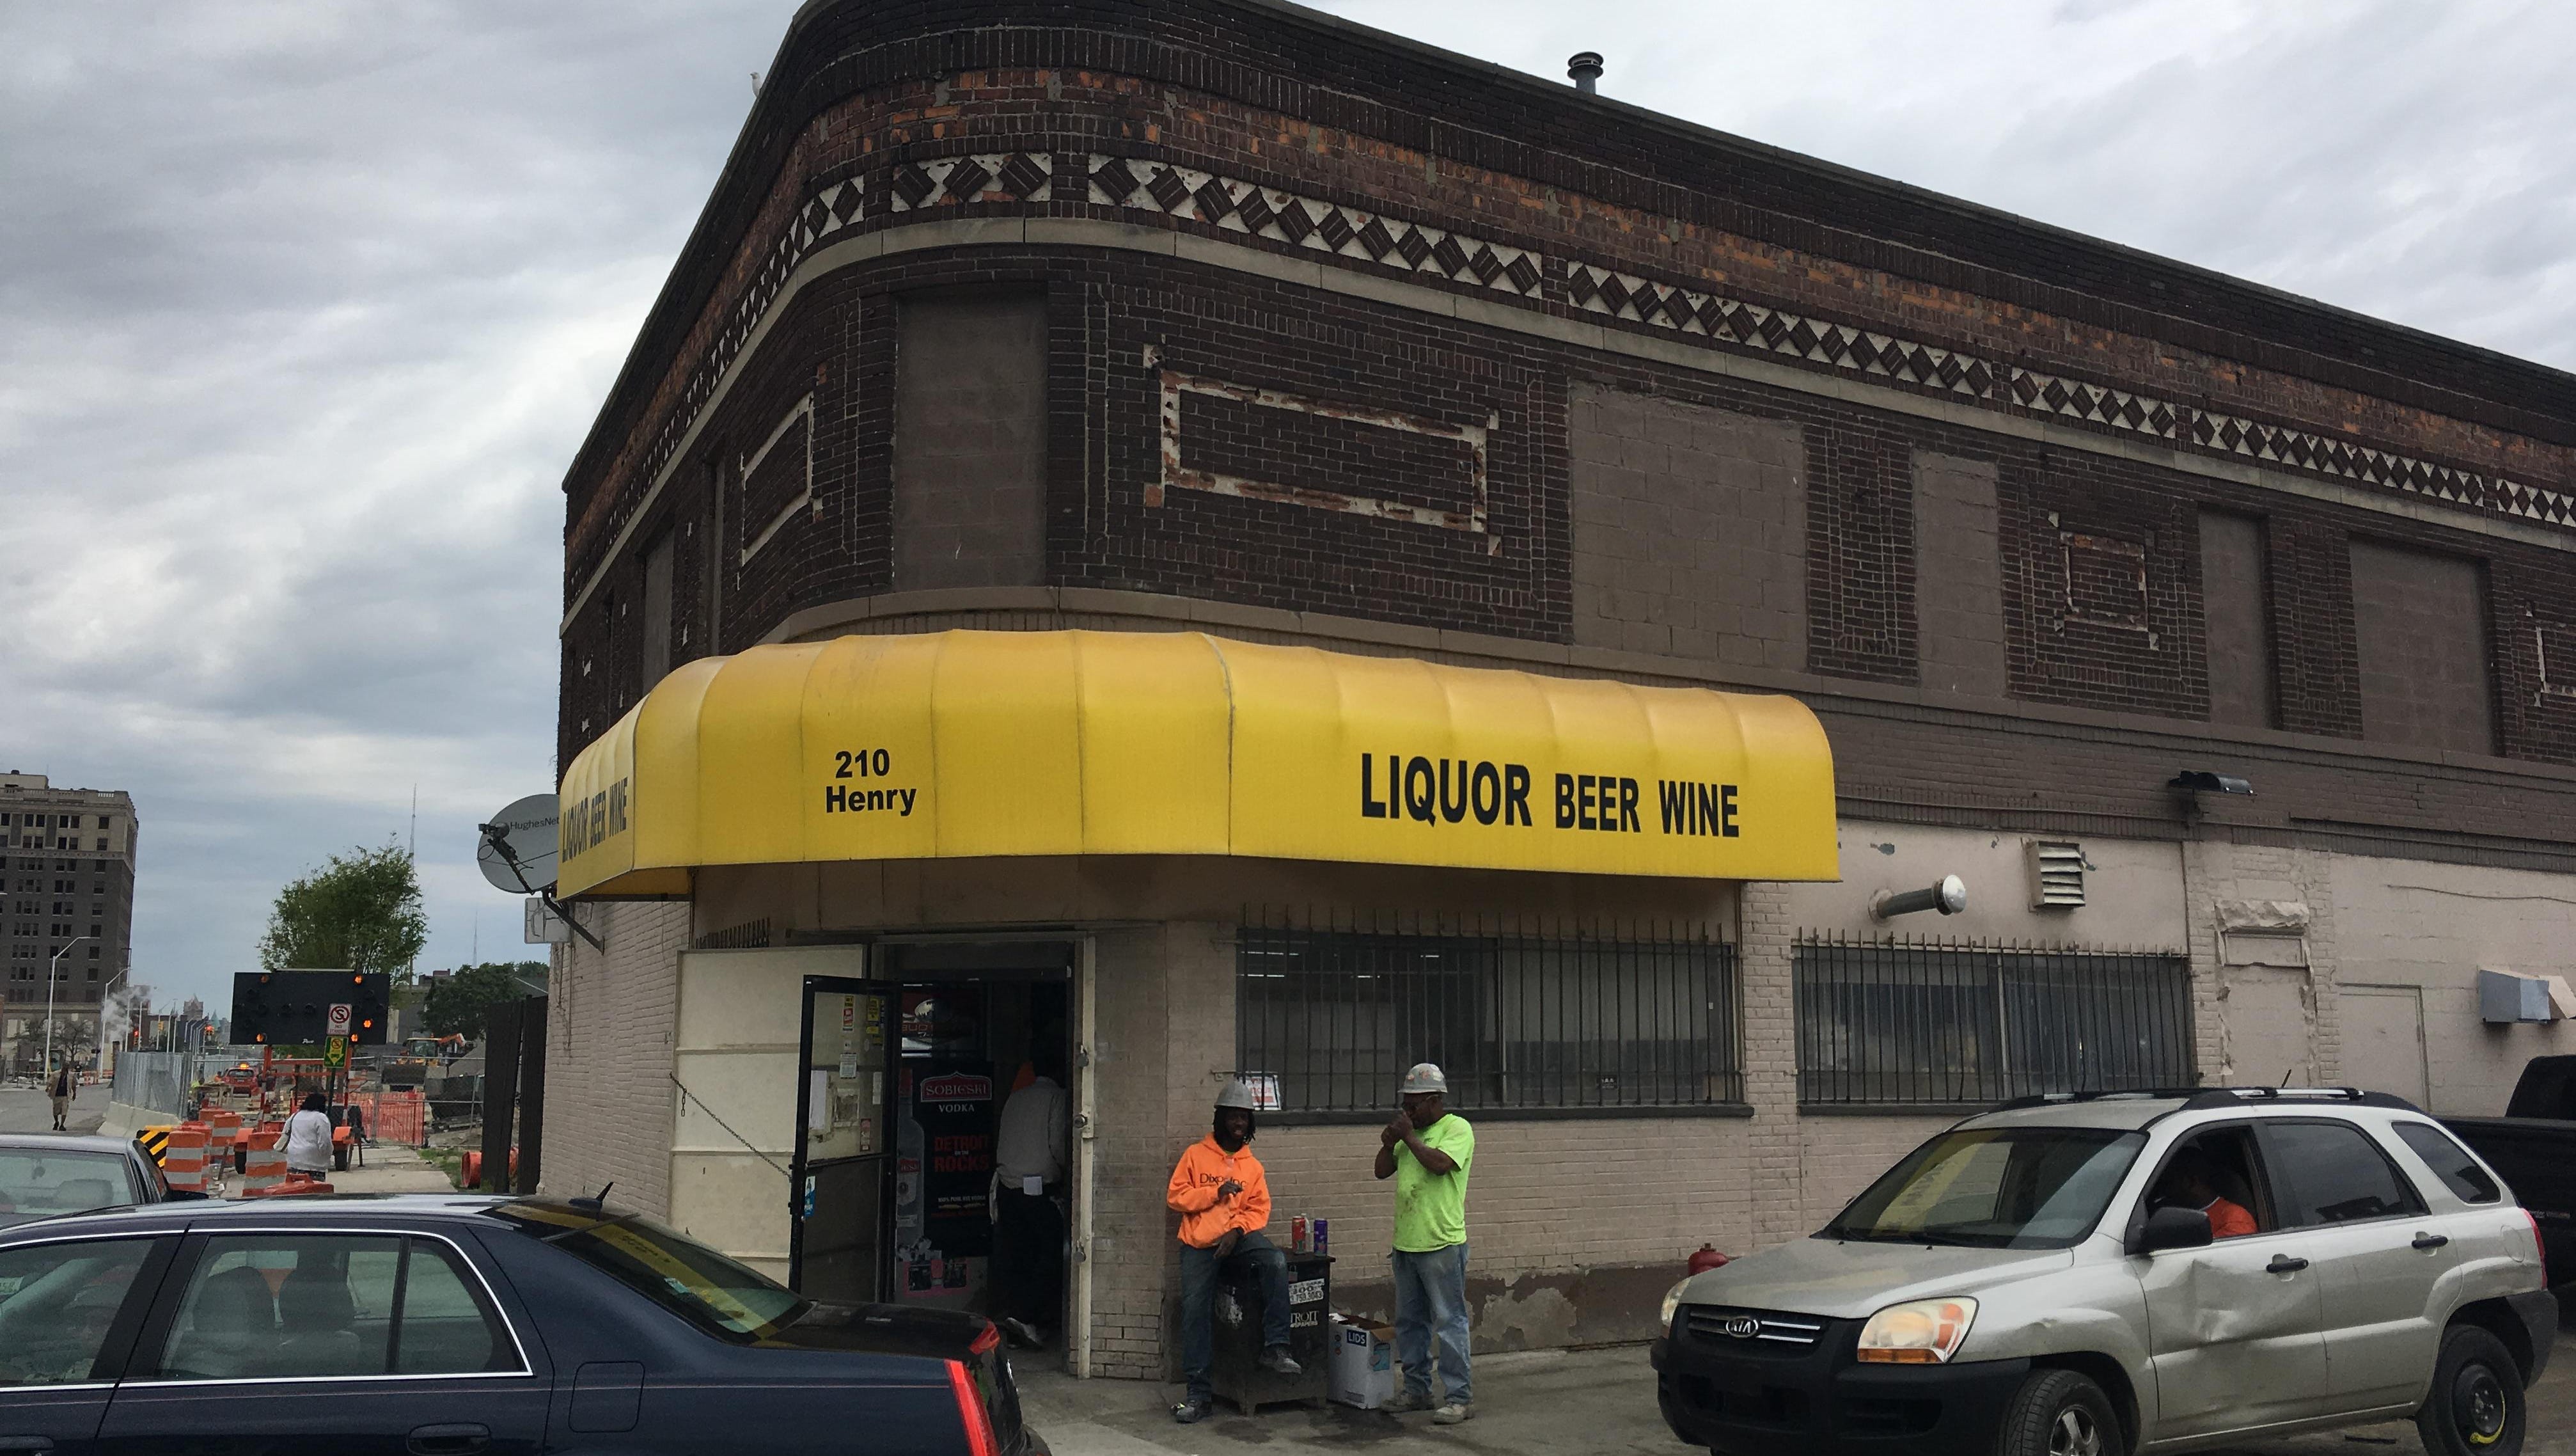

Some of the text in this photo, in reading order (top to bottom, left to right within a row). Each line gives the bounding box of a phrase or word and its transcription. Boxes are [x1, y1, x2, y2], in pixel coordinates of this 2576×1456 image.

[835, 748, 890, 779] 210
[826, 785, 917, 817] Henry
[1361, 752, 1740, 838] LIQUOR BEER WINE
[509, 816, 560, 831] HughesNet
[562, 777, 628, 864] LIQUOR BEER WINE
[925, 1083, 987, 1096] SOBIESKI
[938, 1104, 975, 1113] VODKA
[934, 1136, 989, 1151] DETROIT
[934, 1155, 989, 1172] ROCKS
[1729, 1320, 1752, 1334] KIA
[1348, 1331, 1366, 1345] LIDS
